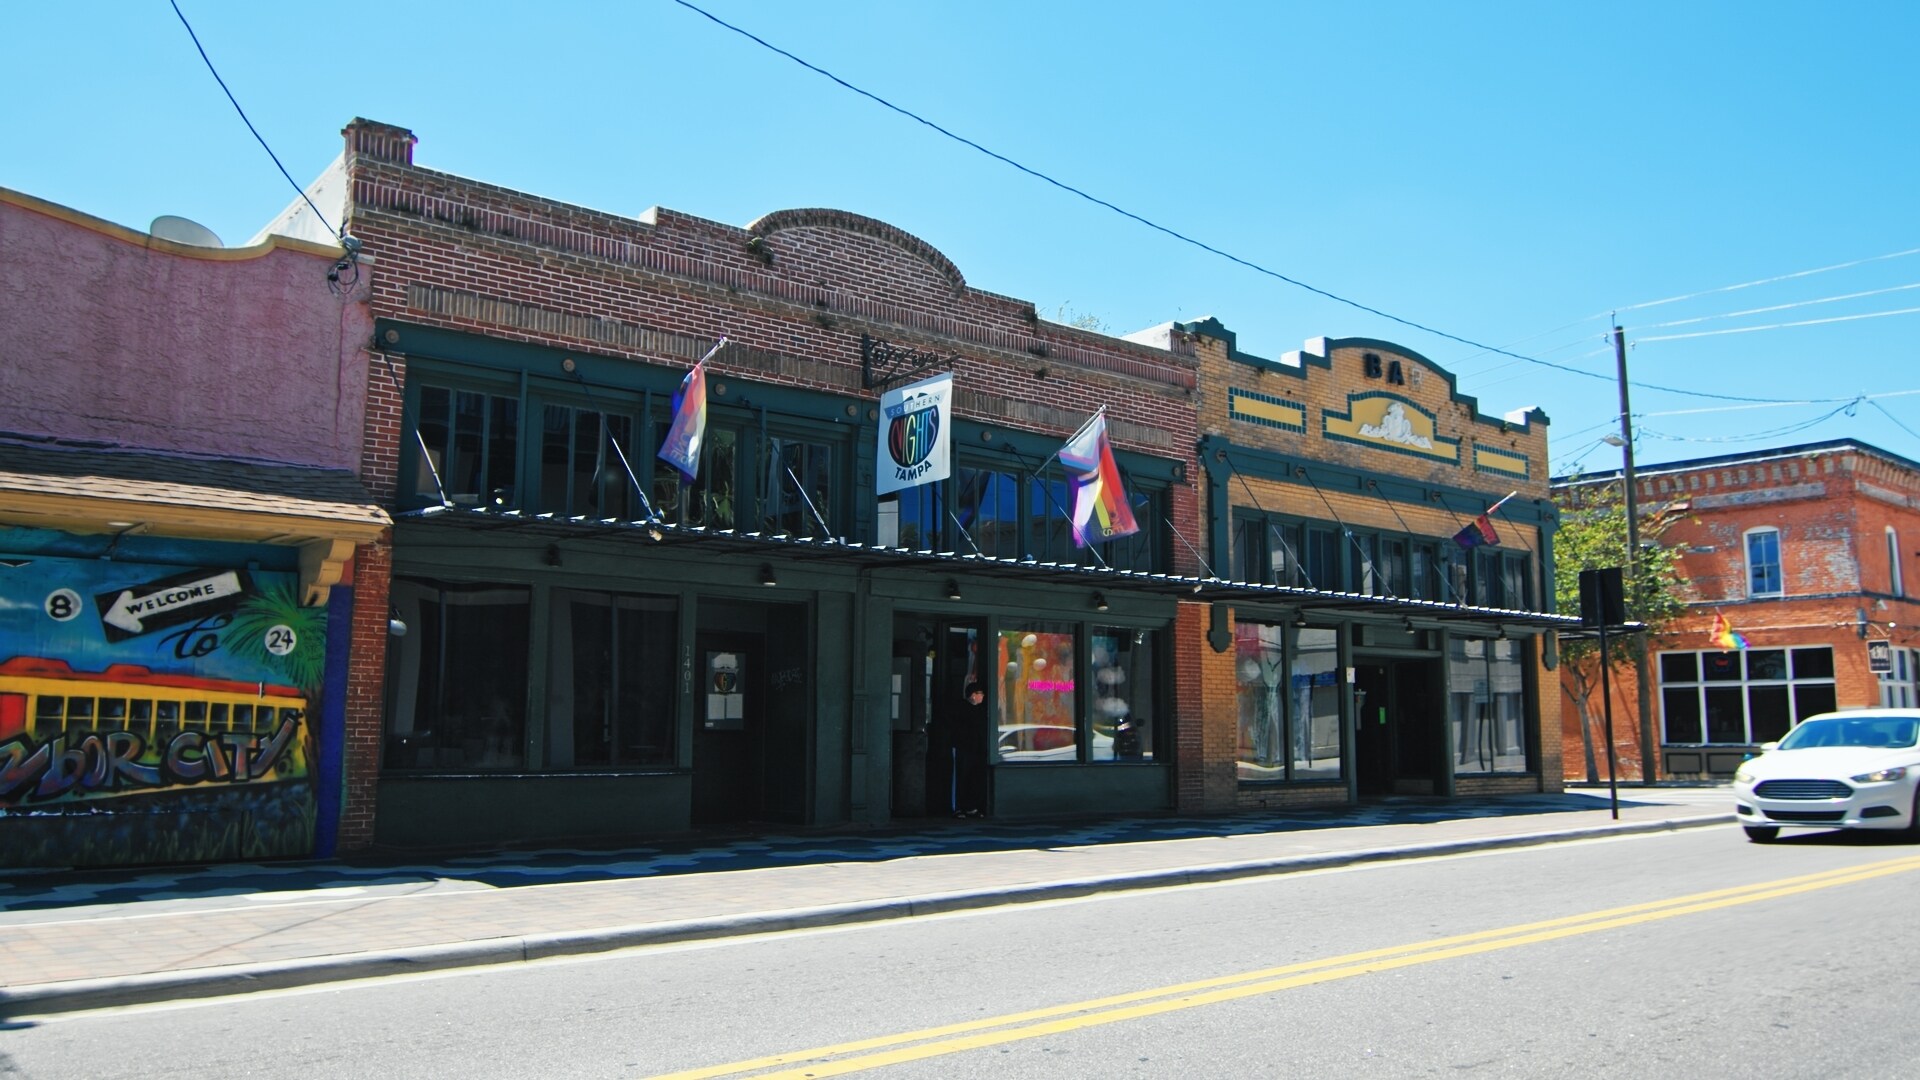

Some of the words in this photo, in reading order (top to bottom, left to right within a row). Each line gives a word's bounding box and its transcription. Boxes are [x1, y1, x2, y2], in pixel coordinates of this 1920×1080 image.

[890, 394, 940, 416] SOUTHERN
[891, 407, 936, 464] NIGHTS
[894, 460, 933, 481] TAMPA
[49, 596, 72, 618] 8
[126, 584, 215, 615] WELCOME
[269, 630, 293, 650] 24
[683, 645, 691, 694] 1401
[165, 710, 298, 783] CITY
